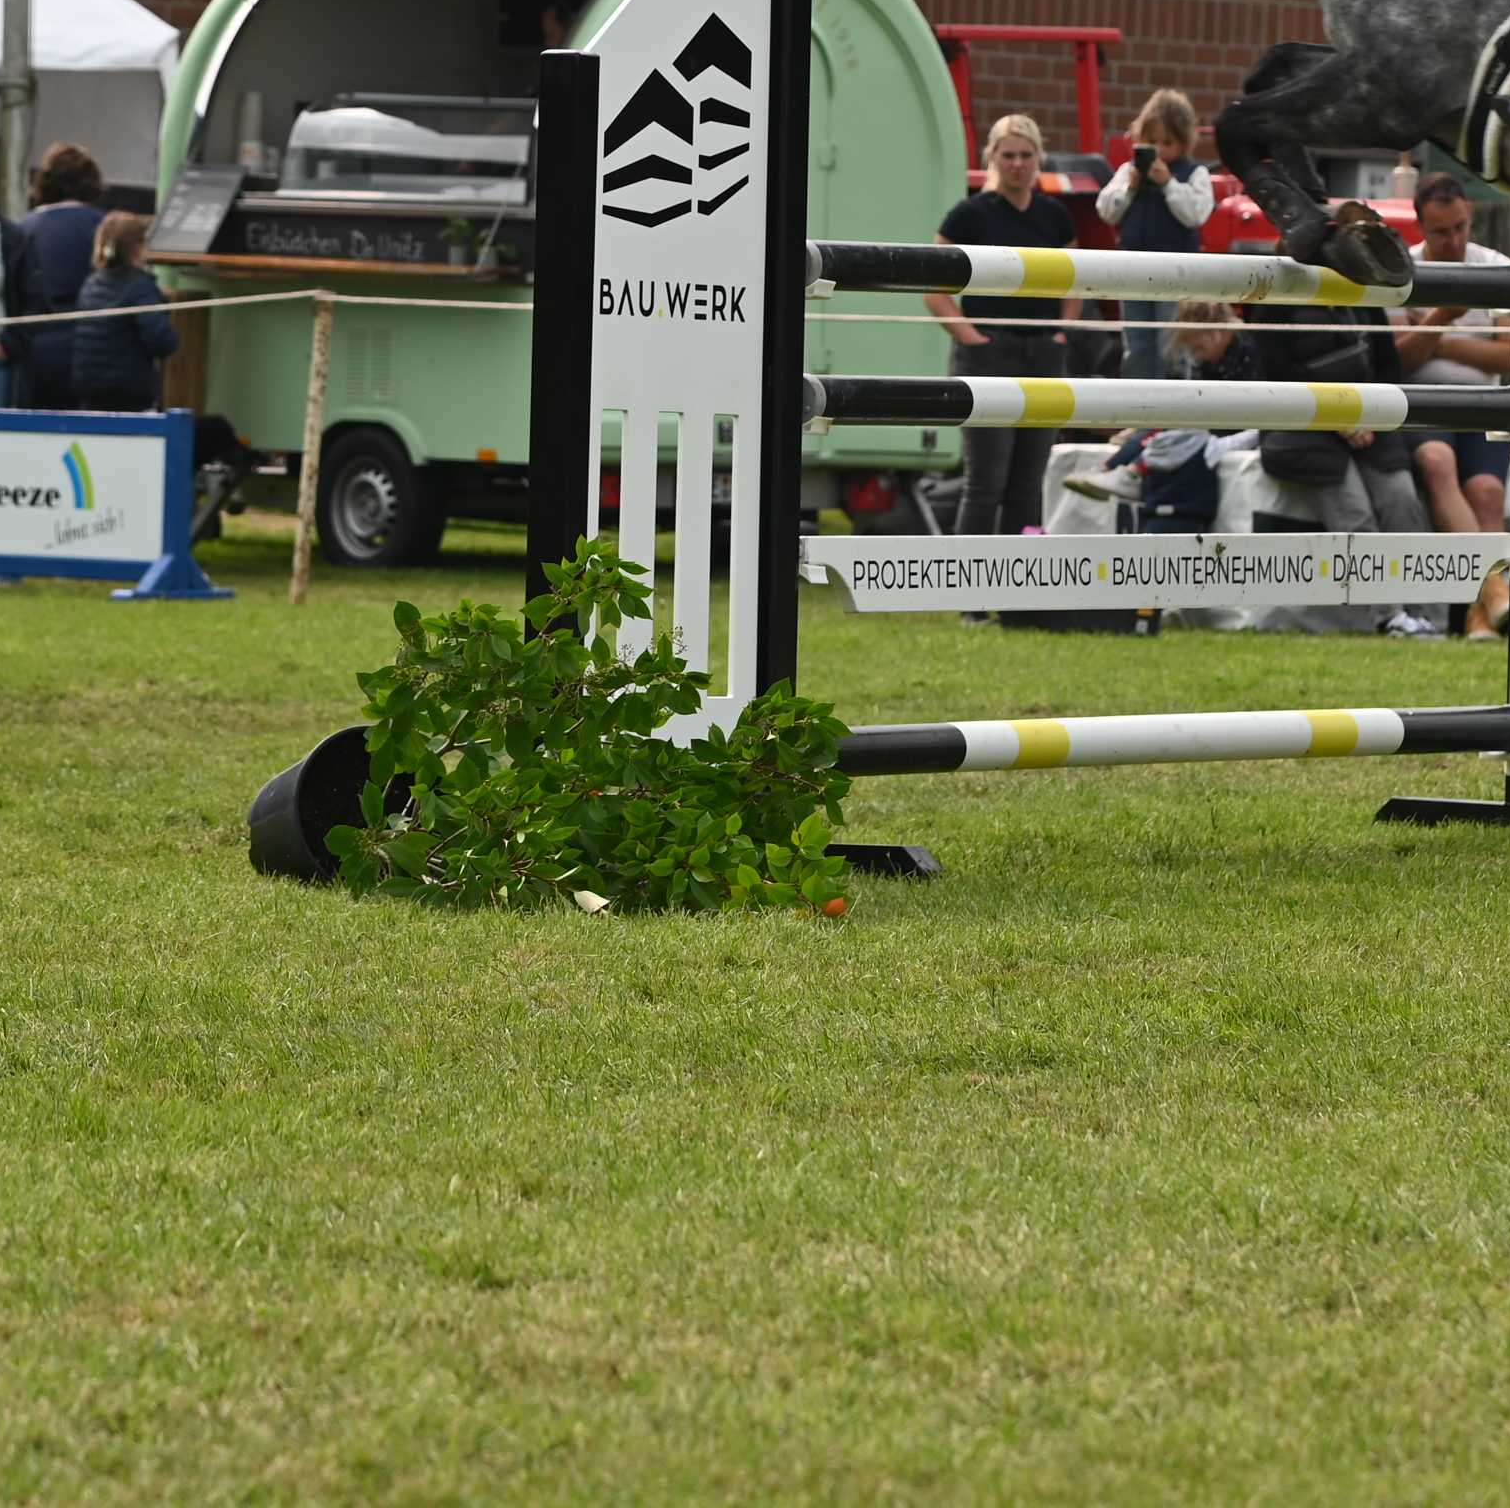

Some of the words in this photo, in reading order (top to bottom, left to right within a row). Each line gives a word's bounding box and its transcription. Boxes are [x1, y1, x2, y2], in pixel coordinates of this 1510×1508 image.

[853, 556, 1092, 590] PROJEKTENTWICKLUNG
[1112, 554, 1314, 586] BAUUNTERNEHMUNG
[1332, 554, 1385, 583] DACH
[1403, 553, 1482, 583] FASSADE
